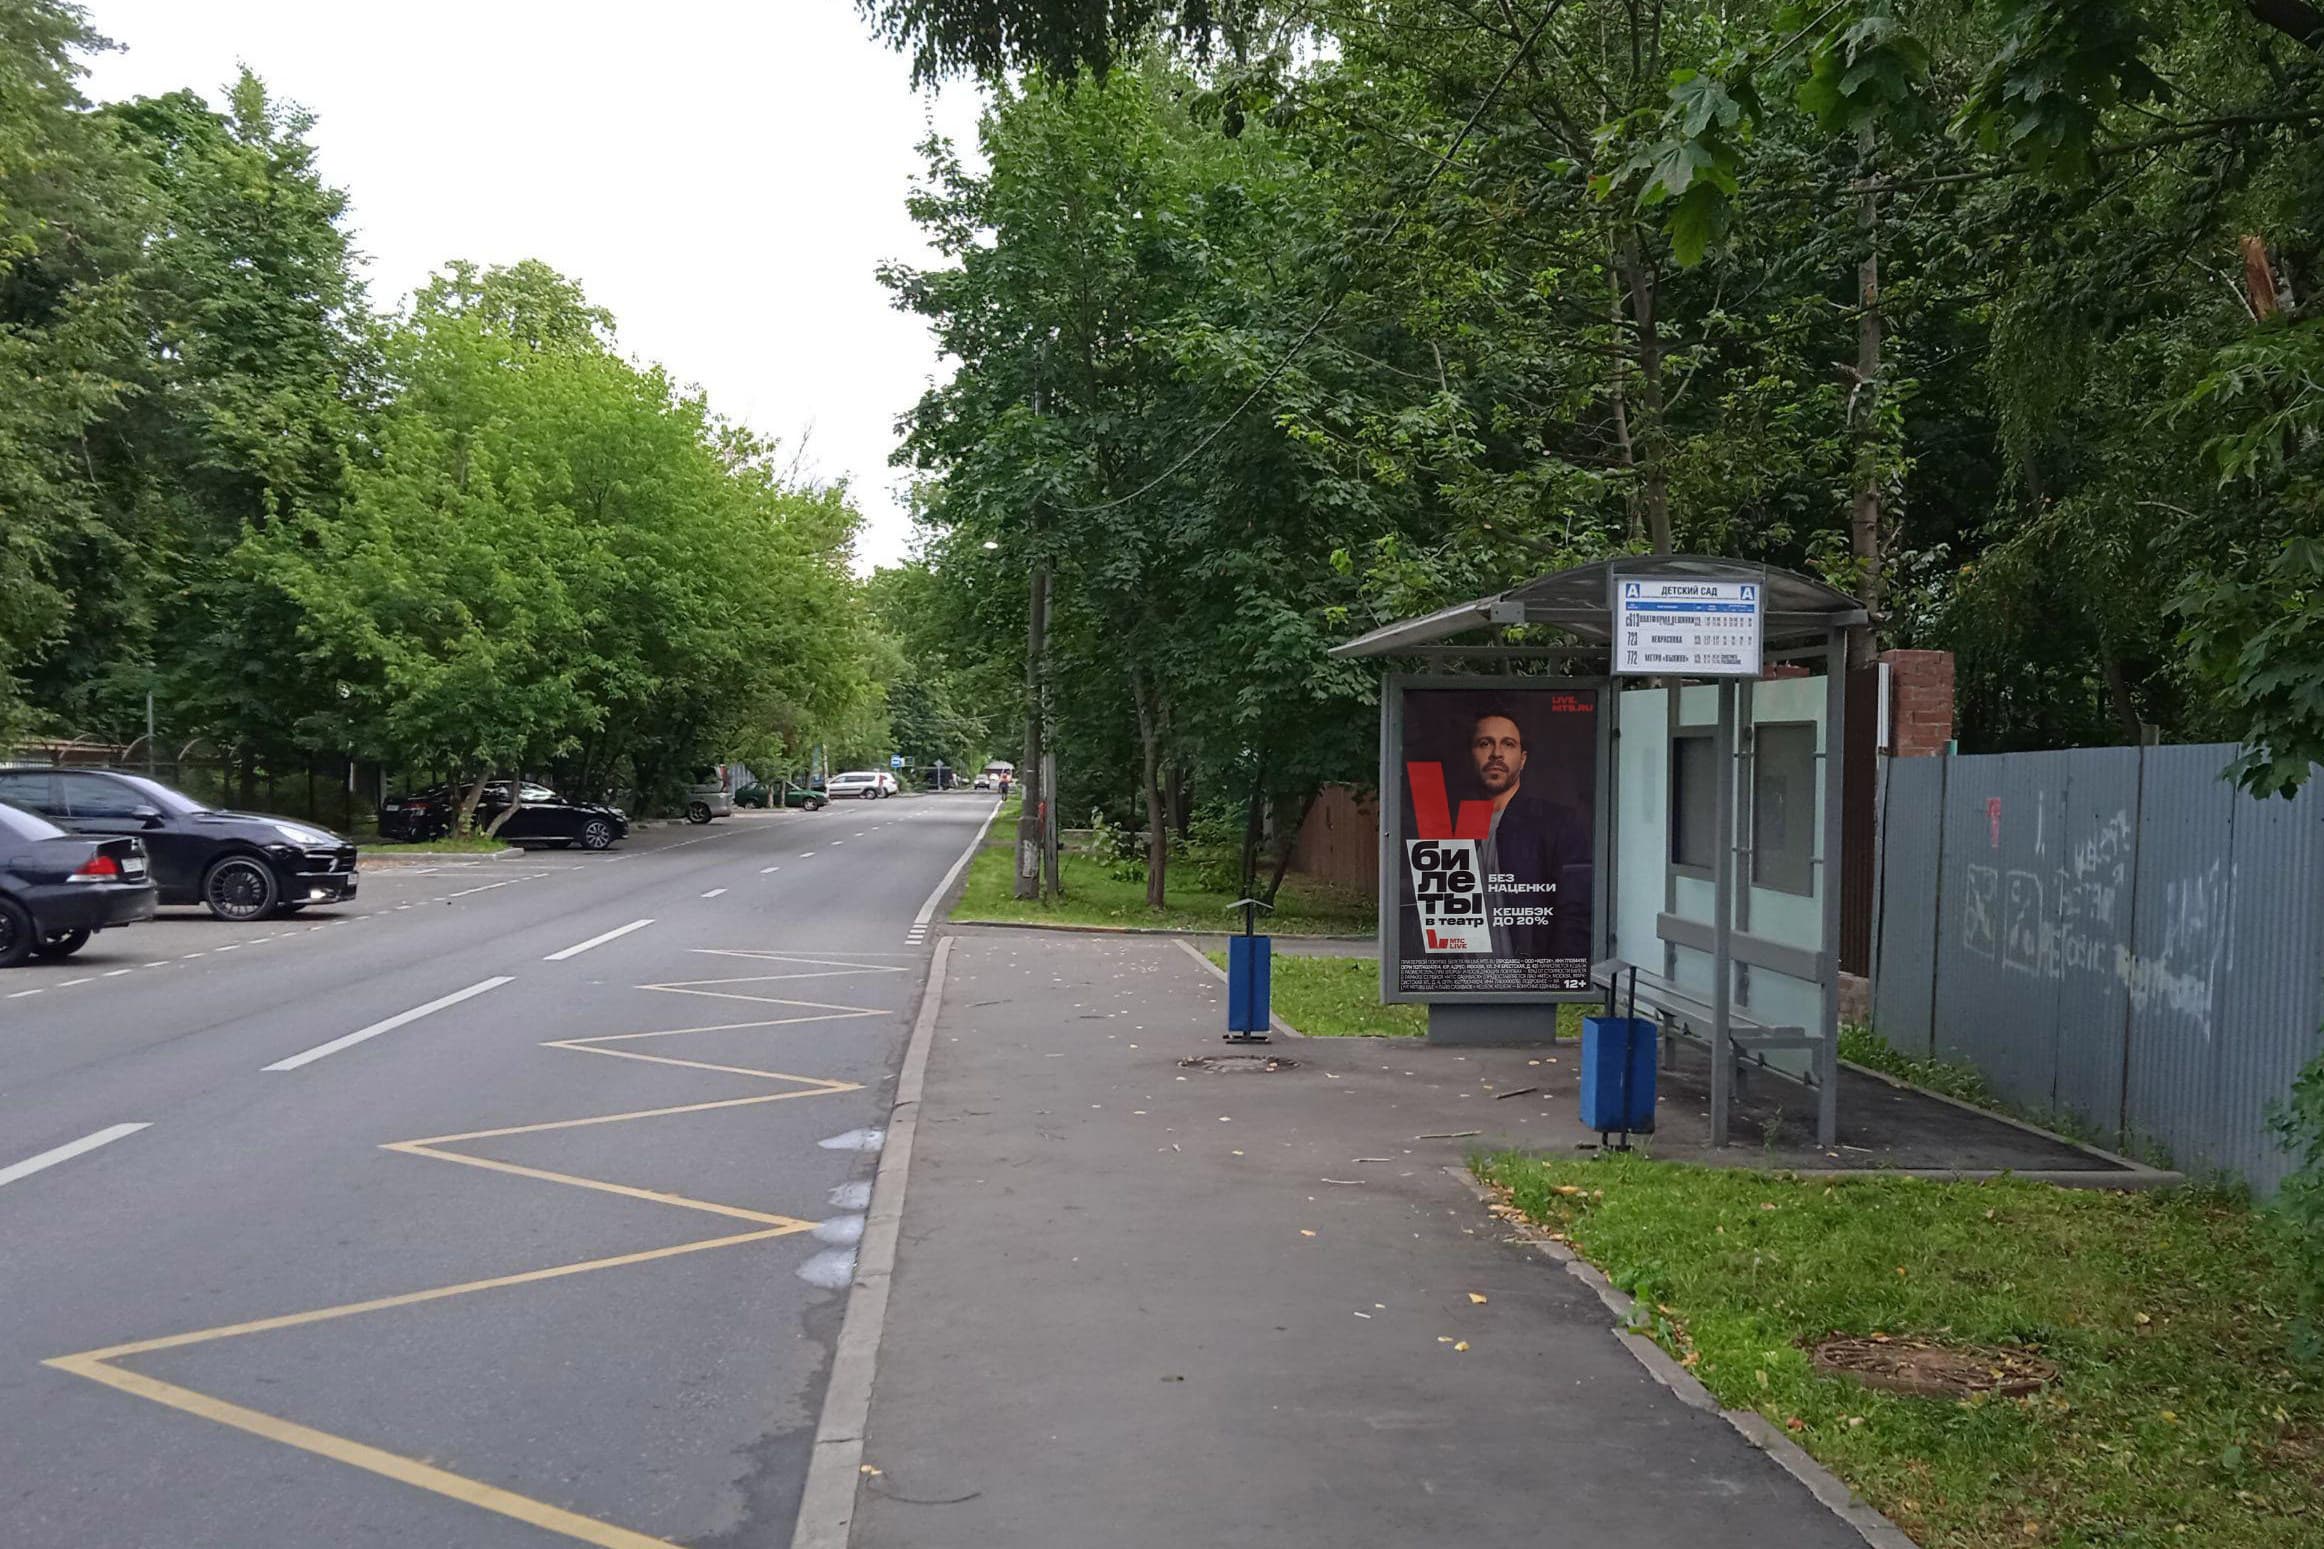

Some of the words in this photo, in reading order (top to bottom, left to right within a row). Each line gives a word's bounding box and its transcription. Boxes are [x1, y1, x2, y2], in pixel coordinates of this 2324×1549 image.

[1661, 585, 1699, 596] ДЕТСКИЙ
[1701, 587, 1718, 597] САД
[1627, 631, 1638, 646] 723
[1626, 650, 1638, 665] 772
[1552, 703, 1594, 712] MTS.RU
[1411, 840, 1470, 871] би
[1417, 870, 1476, 893] ле
[1487, 873, 1515, 883] БЕЗ
[1487, 883, 1557, 894] НАЦЕНКИ
[1417, 892, 1483, 914] ты
[1492, 907, 1554, 916] КЕШБЭК
[1425, 917, 1435, 926] в
[1438, 917, 1484, 928] театр
[1492, 916, 1514, 926] ДО
[1516, 916, 1549, 925] 20%
[1563, 979, 1587, 989] 12+
